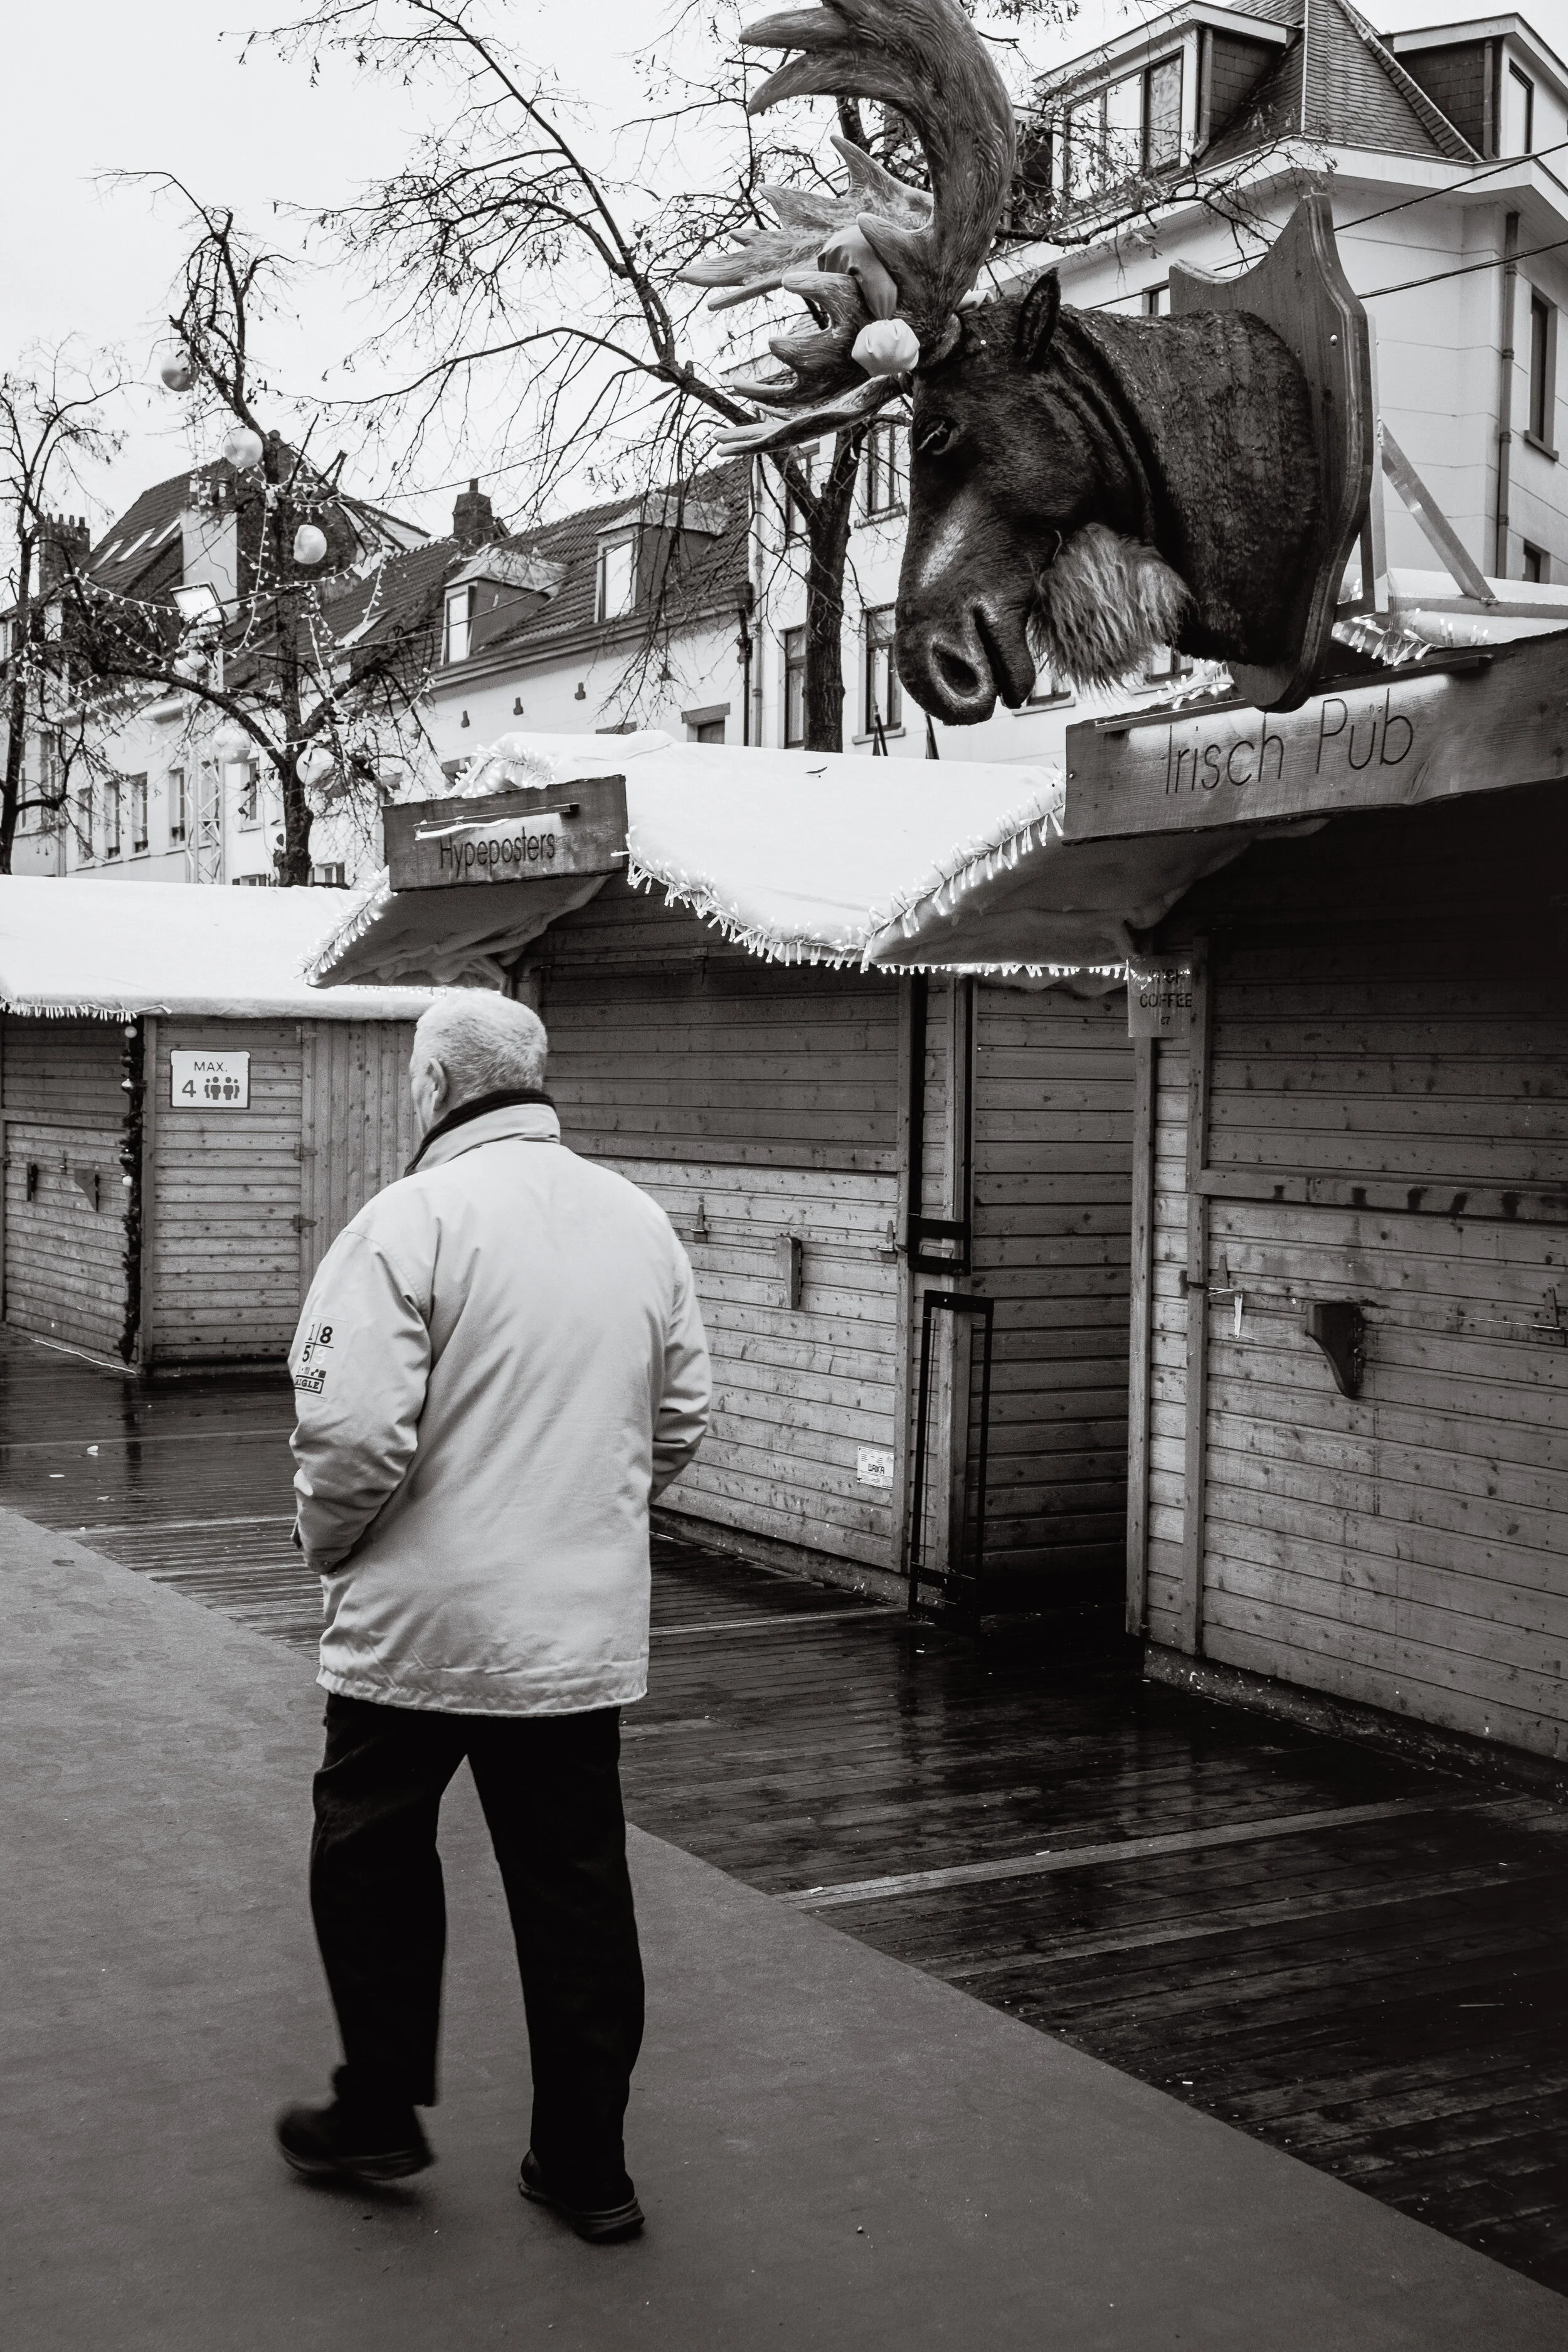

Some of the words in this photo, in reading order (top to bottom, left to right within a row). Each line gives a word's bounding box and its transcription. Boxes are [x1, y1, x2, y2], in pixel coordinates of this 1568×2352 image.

[1165, 712, 1285, 795] Irisch
[1316, 689, 1414, 774] Pub
[439, 826, 556, 877] Hypeposters
[1140, 992, 1192, 1008] COFFEE
[194, 1061, 228, 1072] MAX.
[182, 1079, 196, 1098] 4
